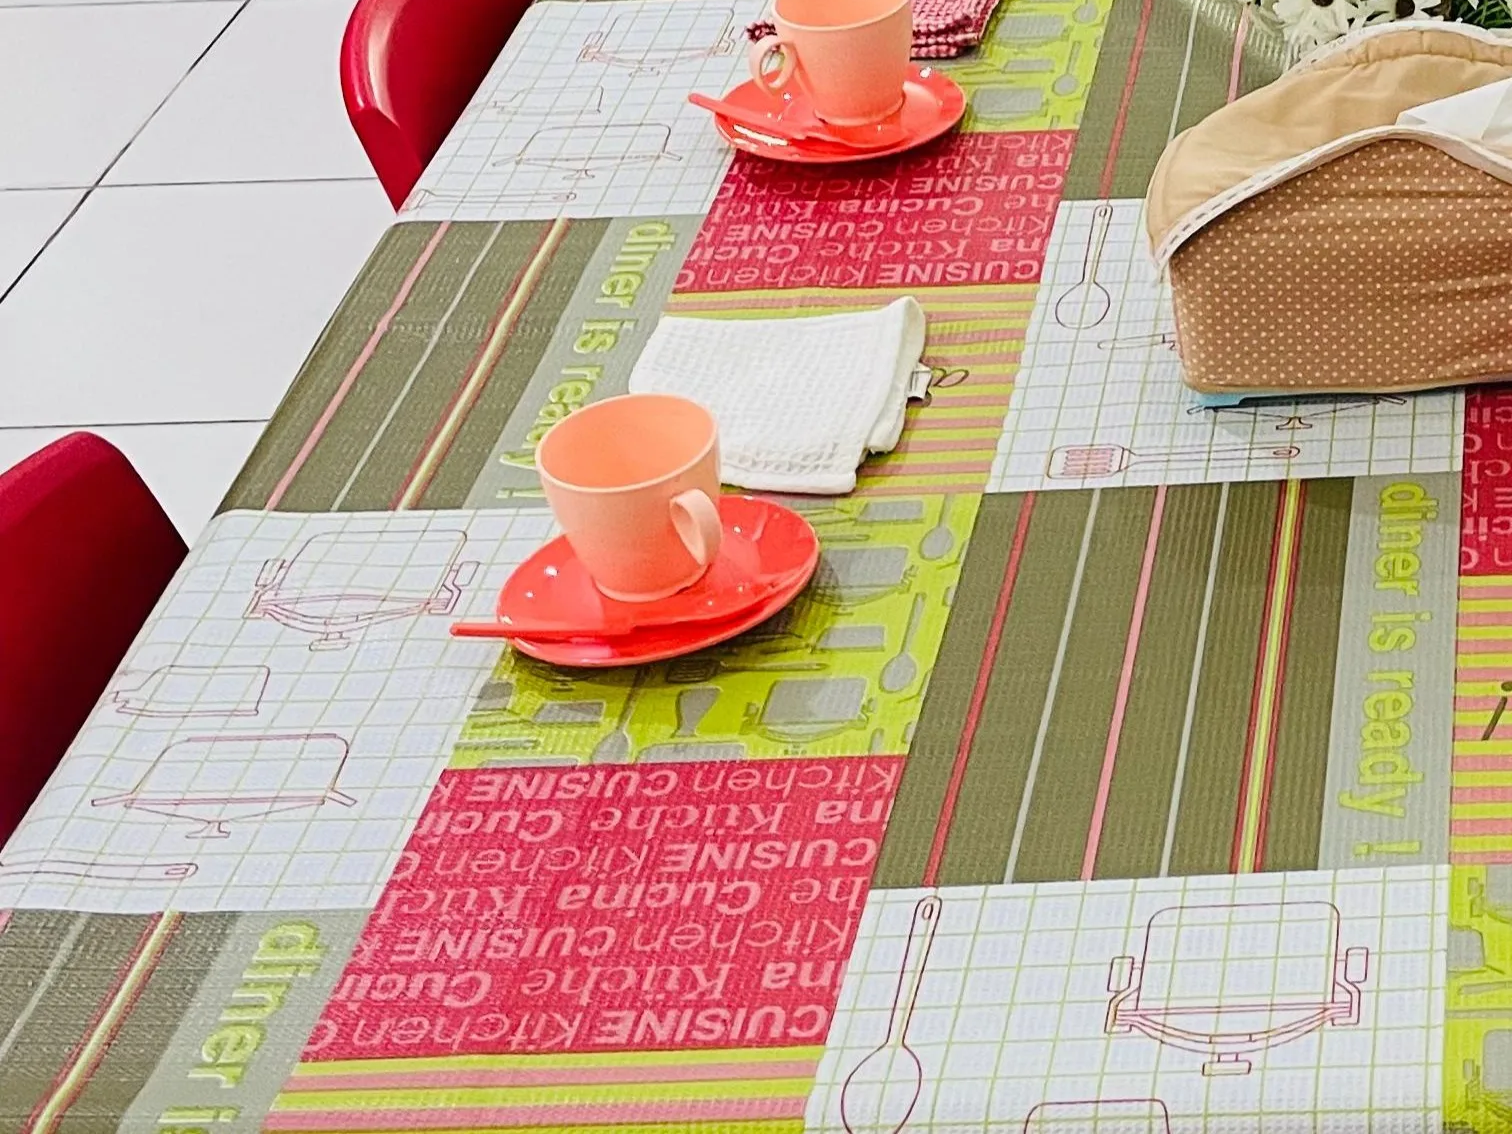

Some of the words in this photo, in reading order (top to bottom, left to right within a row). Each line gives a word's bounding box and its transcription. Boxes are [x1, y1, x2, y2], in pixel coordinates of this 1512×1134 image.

[909, 173, 1063, 194] CUISINE
[837, 196, 985, 217] Cucina
[892, 214, 1052, 236] Kitchen
[718, 219, 884, 242] CUISINE
[595, 220, 677, 310] diner
[706, 263, 868, 289] Kitchen
[876, 259, 1040, 285] CUISINE
[573, 318, 639, 354] is
[1372, 481, 1440, 598] diner
[1367, 610, 1433, 654] is
[1337, 669, 1425, 819] ready
[466, 770, 679, 802] CUISINE
[693, 761, 900, 795] Kitchen
[435, 841, 649, 880] Kitchen
[660, 837, 878, 873] CUISINE
[557, 879, 761, 916] Cucina
[391, 924, 617, 963] CUISINE
[631, 916, 853, 956] Kitchen
[187, 920, 330, 1089] diner
[353, 1010, 583, 1050] Kitchen
[595, 1003, 829, 1044] CUISINE
